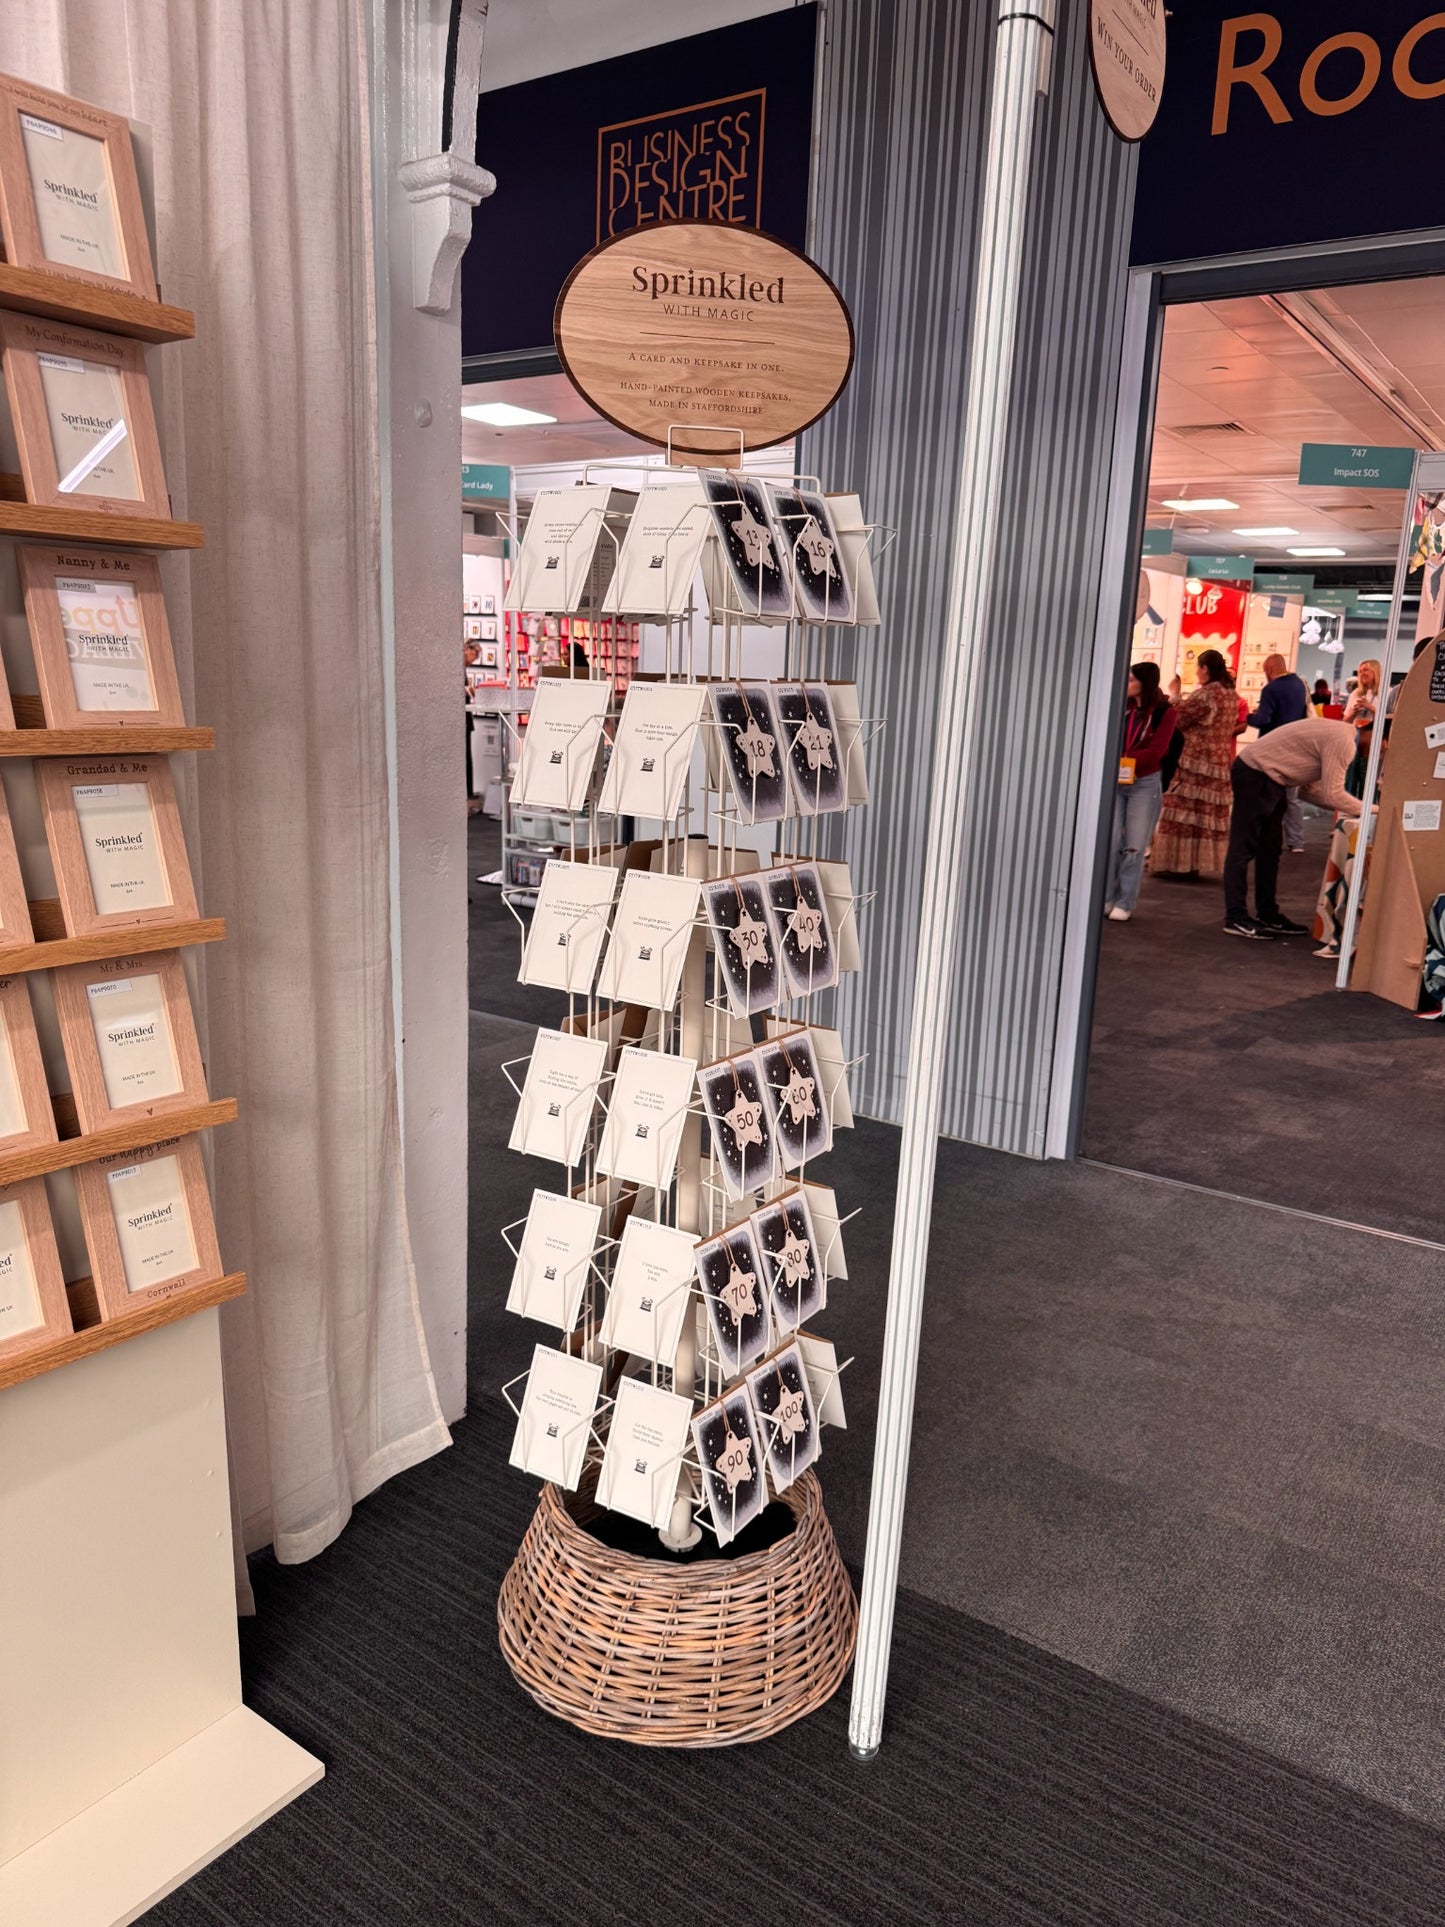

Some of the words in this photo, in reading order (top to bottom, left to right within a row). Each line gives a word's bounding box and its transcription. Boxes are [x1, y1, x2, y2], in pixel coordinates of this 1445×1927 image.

[1098, 16, 1113, 51] WIN
[1114, 42, 1133, 76] YOUR
[1135, 68, 1156, 103] ORDER
[81, 110, 108, 127] heart
[610, 111, 751, 168] BUSINESS
[609, 146, 748, 210] DESIGN
[44, 179, 97, 204] Sprinkled
[632, 266, 785, 303] Sprinkled
[663, 304, 700, 317] WITH
[707, 308, 755, 321] MAGIC
[25, 325, 40, 341] My
[43, 329, 105, 351] Confirmation
[107, 343, 124, 358] Day
[628, 352, 636, 361] A
[640, 353, 666, 363] CARD
[670, 356, 690, 365] AND
[694, 358, 743, 369] KEEPSAKE
[761, 364, 785, 372] ONE.
[620, 382, 692, 394] HAND-PAINTED
[695, 387, 735, 397] WOODEN
[649, 400, 675, 408] MADE
[678, 401, 689, 409] IN
[691, 402, 763, 414] STAFFORDSHIRE
[1351, 448, 1367, 458] 747
[1334, 468, 1361, 478] Impact
[1363, 468, 1380, 478] SOS
[462, 481, 475, 489] ard
[477, 481, 494, 491] Lady
[810, 541, 826, 558] 16
[57, 555, 96, 570] Nanny
[101, 558, 109, 569] &
[114, 560, 130, 571] Me
[750, 740, 766, 758] 18
[808, 734, 824, 750] 21
[67, 764, 116, 776] Grandad
[120, 763, 128, 773] &
[132, 763, 148, 773] Me
[95, 833, 142, 848] Sprinkled
[799, 916, 814, 933] 40
[741, 931, 758, 950] 30
[101, 965, 113, 973] Mr
[115, 961, 124, 971] &
[127, 960, 143, 969] Mrs
[108, 1025, 154, 1043] Sprinkled
[792, 1086, 807, 1104] 60
[737, 1110, 753, 1130] 50
[128, 1205, 172, 1227] Sprinkled
[786, 1249, 802, 1268] 80
[147, 1278, 186, 1298] Cornwall
[731, 1284, 748, 1306] 70
[780, 1401, 798, 1422] 100
[728, 1449, 743, 1473] 90
